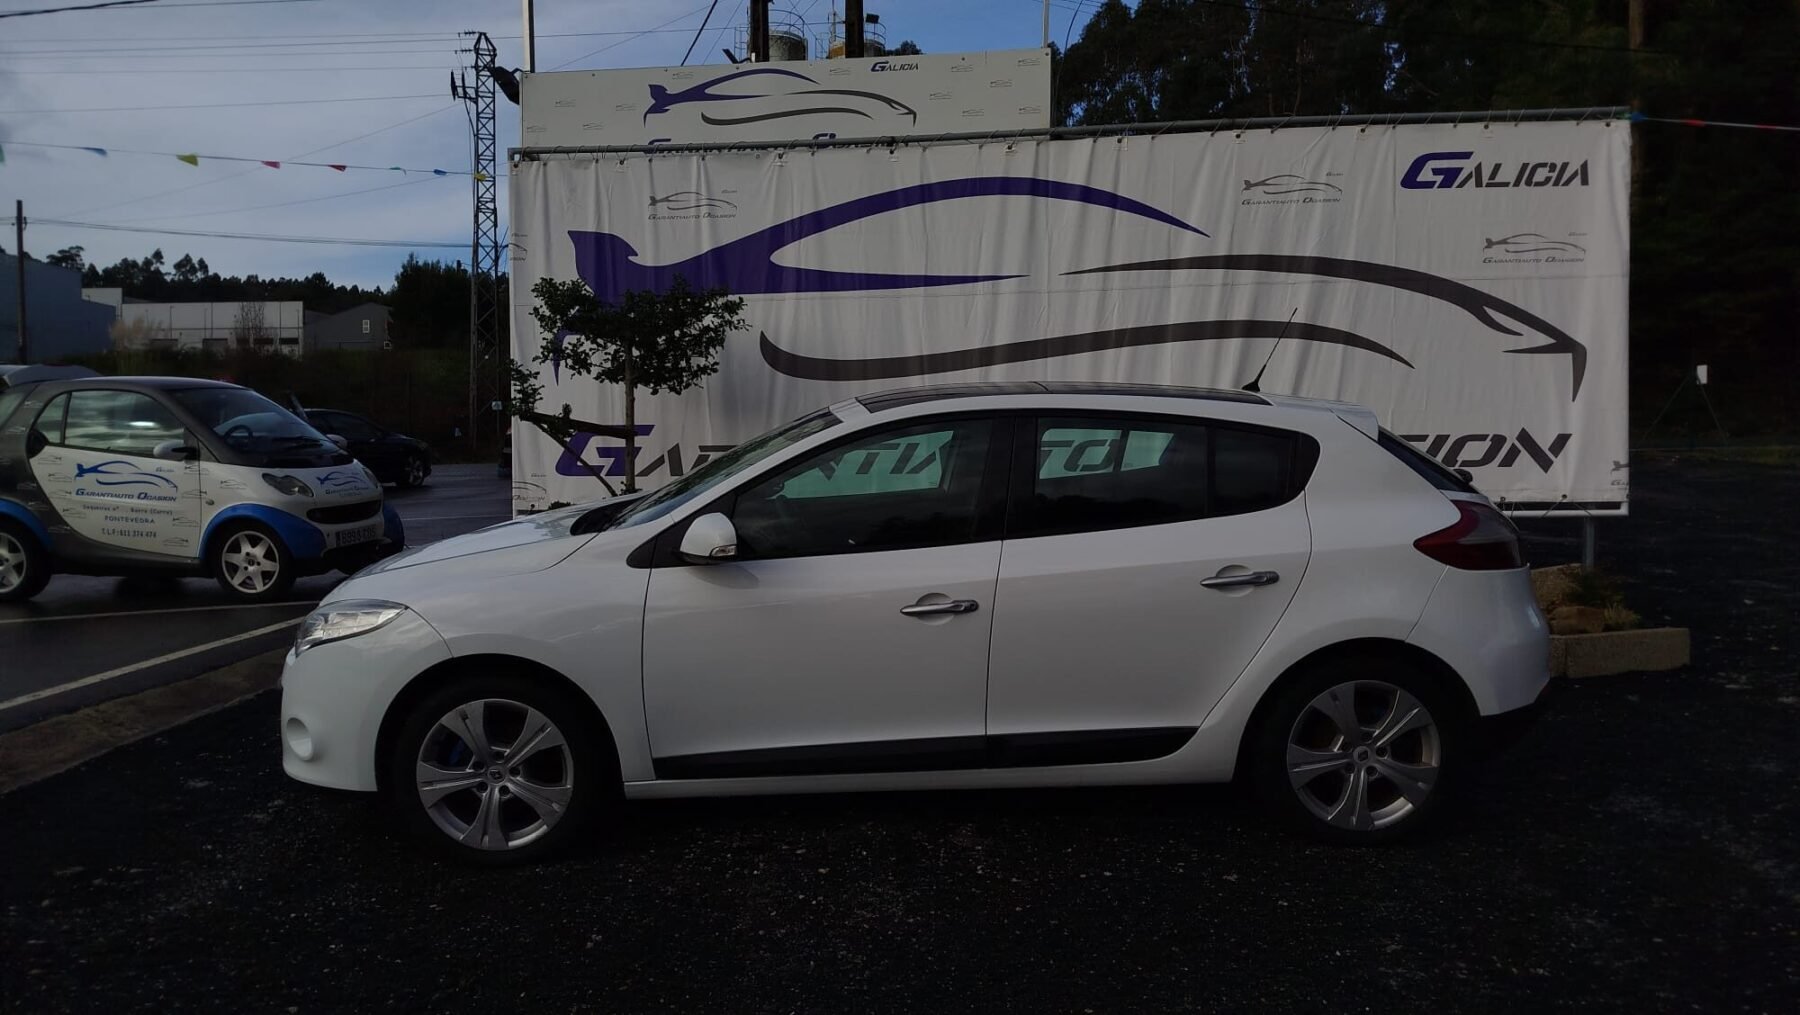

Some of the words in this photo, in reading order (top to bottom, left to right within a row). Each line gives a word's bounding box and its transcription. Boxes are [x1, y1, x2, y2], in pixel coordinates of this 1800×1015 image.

[870, 60, 920, 72] GALICIA
[1400, 151, 1590, 189] GALICIA
[75, 489, 135, 499] GARANTIAUTO
[137, 492, 177, 502] OCASION
[104, 516, 155, 524] PONTEVEDRA
